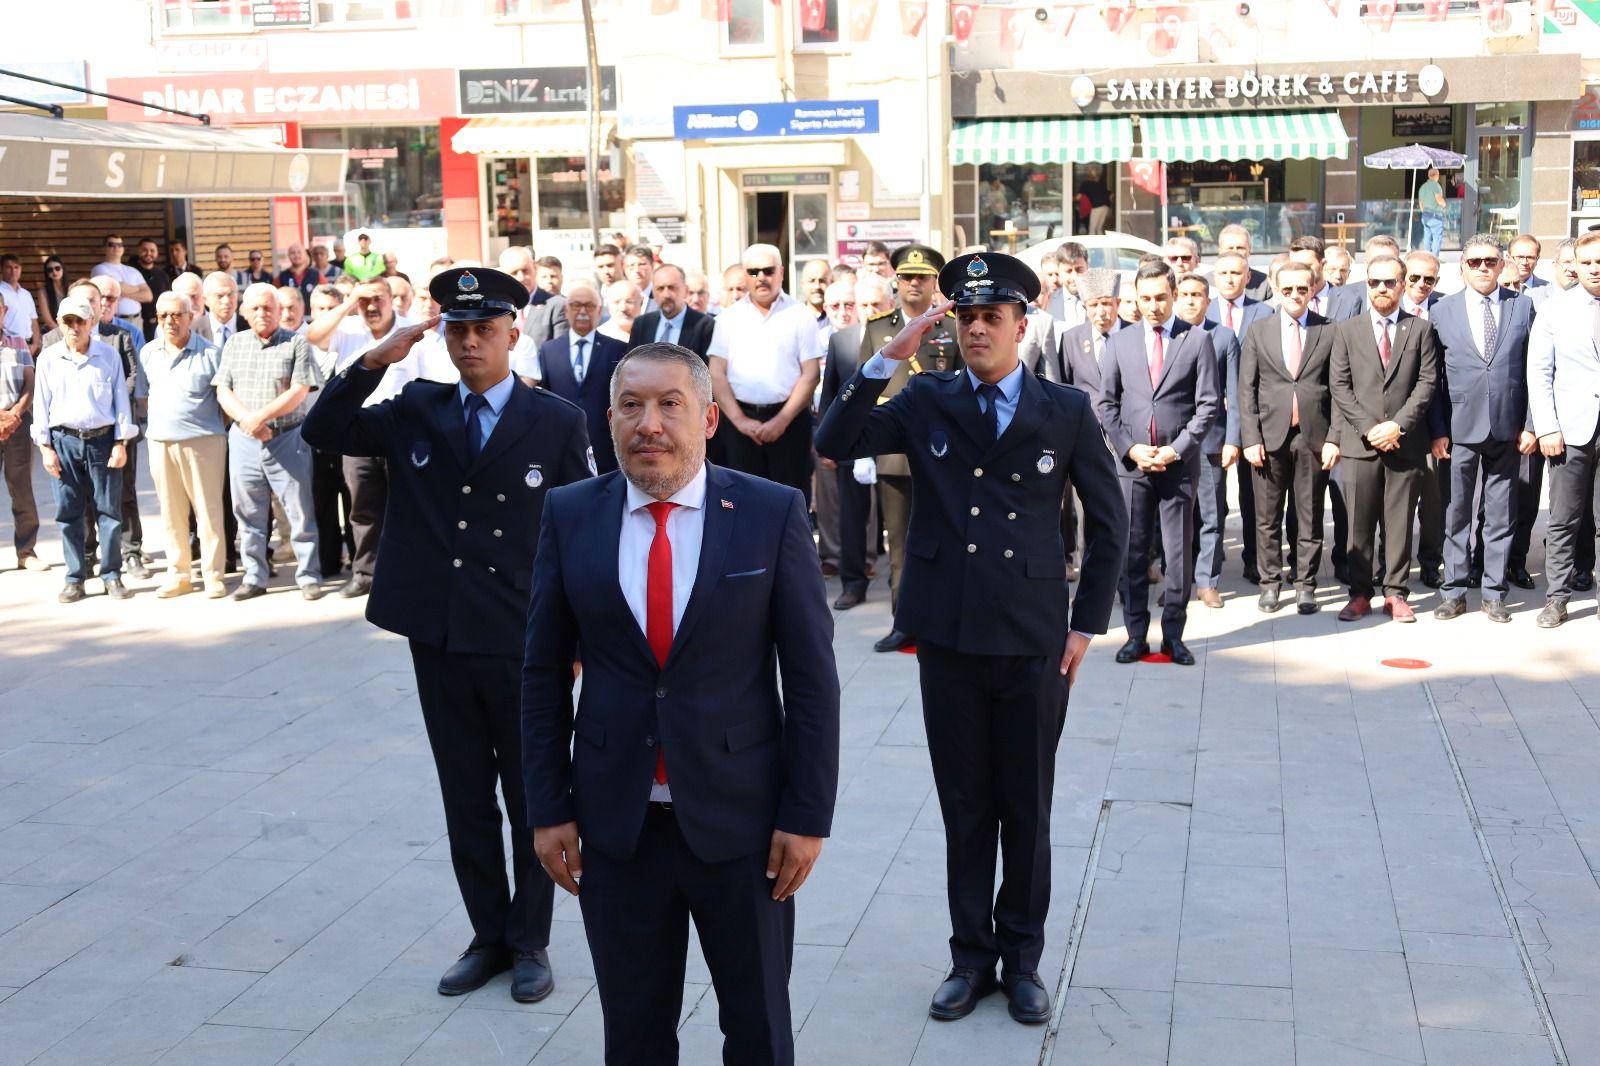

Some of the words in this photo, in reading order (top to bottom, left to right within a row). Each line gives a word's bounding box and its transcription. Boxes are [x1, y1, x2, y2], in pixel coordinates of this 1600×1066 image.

[253, 78, 420, 112] ECZANESİ
[1107, 76, 1215, 101] SARIYER
[1224, 70, 1309, 98] BÖREK
[1318, 73, 1334, 94] &
[1343, 70, 1408, 94] CAFE
[687, 113, 737, 129] Allianz
